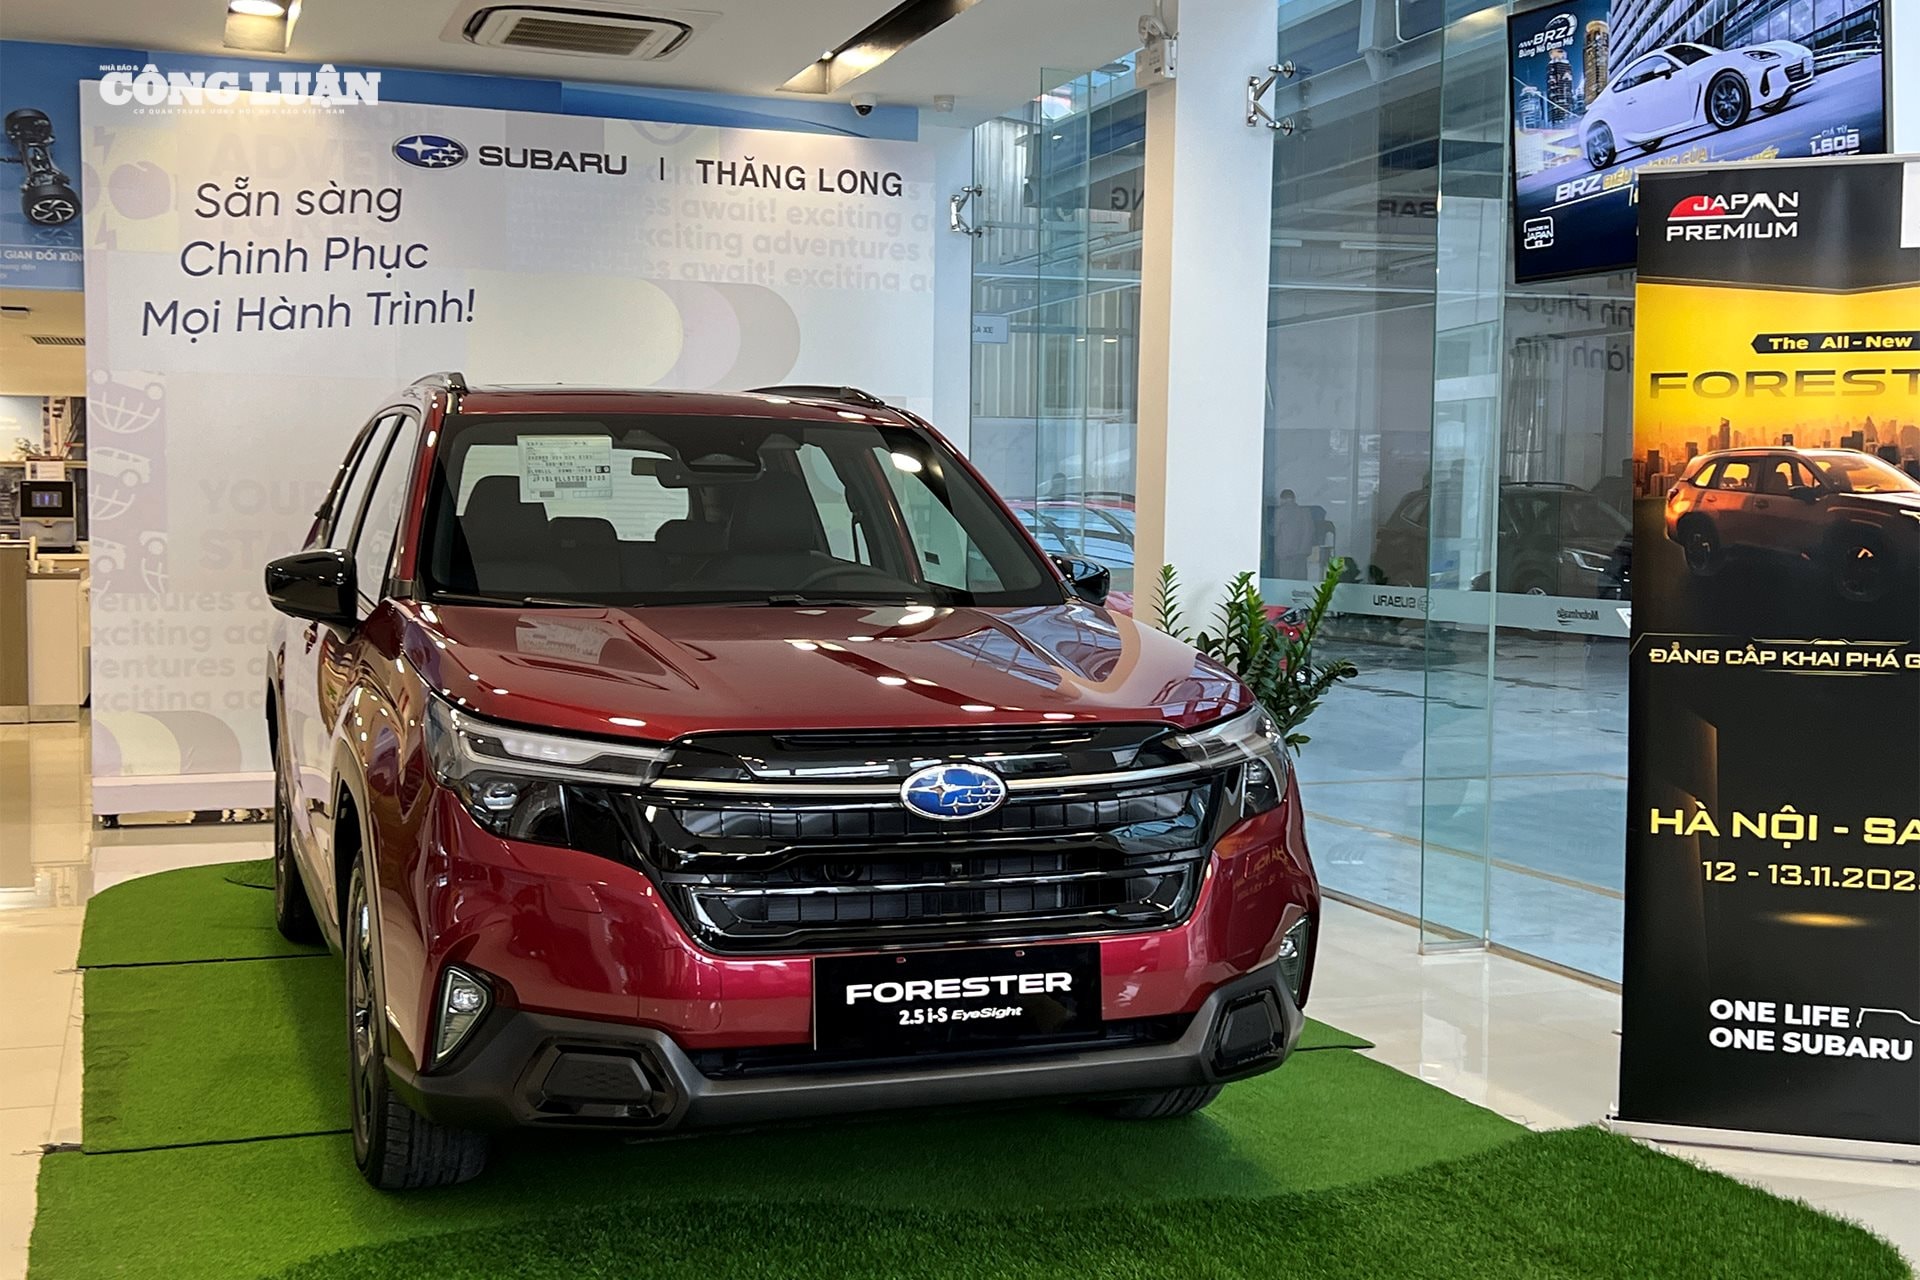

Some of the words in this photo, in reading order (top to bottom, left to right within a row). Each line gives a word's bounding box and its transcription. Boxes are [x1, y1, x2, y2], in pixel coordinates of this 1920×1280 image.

[1533, 26, 1568, 46] BRZ
[479, 144, 627, 176] SUBARU
[696, 155, 806, 192] THĂNG
[818, 168, 904, 198] LONG
[194, 176, 280, 220] Sẵn
[295, 180, 403, 223] sàng
[1555, 173, 1602, 202] BRZ
[1692, 191, 1798, 216] JAPAN
[752, 228, 921, 261] adventures
[1666, 221, 1798, 242] PREMIUM
[180, 238, 308, 277] Chinh
[325, 235, 430, 280] Phục
[142, 299, 219, 345] Mọi
[237, 292, 351, 334] Hành
[367, 287, 476, 327] Trình!
[1768, 336, 1809, 350] The
[1820, 334, 1913, 349] All-New
[1649, 368, 1920, 399] FOREST
[1649, 641, 1720, 664] ĐẲNG
[1725, 643, 1777, 665] CẤP
[1782, 650, 1839, 667] KHAI
[1846, 648, 1901, 668] PHÁ
[1649, 800, 1720, 837] HÀ
[1731, 804, 1818, 849] NỘI
[1863, 817, 1920, 845] SA
[1702, 860, 1737, 882] 12
[1767, 863, 1920, 892] 13.11.202
[846, 971, 1073, 1005] FORESTER
[899, 1009, 925, 1025] 2.5
[928, 1006, 948, 1023] i-S
[951, 1006, 1023, 1021] EyeSight
[1709, 998, 1776, 1023] ONE
[1784, 1002, 1850, 1028] LIFE
[1709, 1027, 1775, 1051] ONE
[1782, 1031, 1914, 1061] SUBARU
